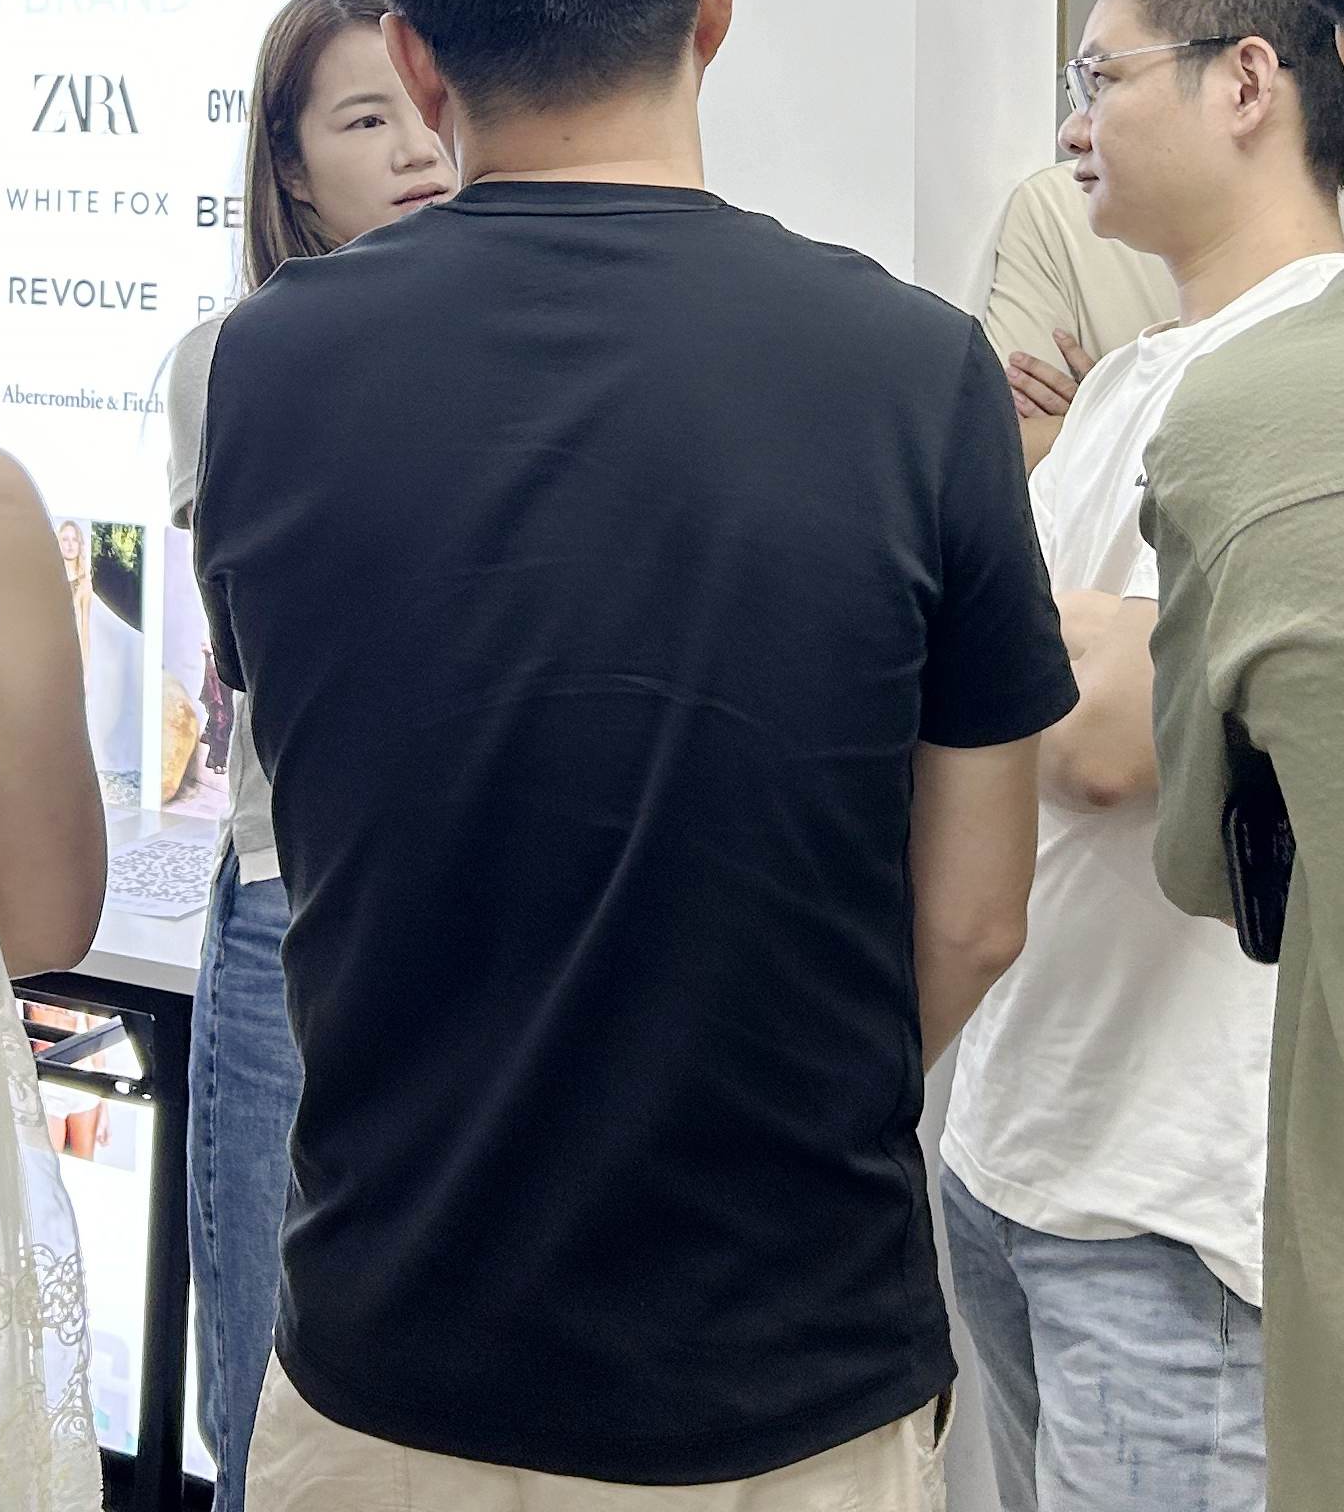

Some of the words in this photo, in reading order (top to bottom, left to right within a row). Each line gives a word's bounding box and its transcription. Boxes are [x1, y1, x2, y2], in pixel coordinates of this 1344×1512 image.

[31, 73, 139, 135] ZARA
[7, 187, 99, 213] WHITE
[114, 191, 169, 216] FOX
[196, 195, 243, 228] BE
[9, 276, 157, 311] REVOLVE
[2, 384, 104, 410] Abercrombie
[106, 395, 118, 410] &
[122, 391, 164, 414] Fitch
